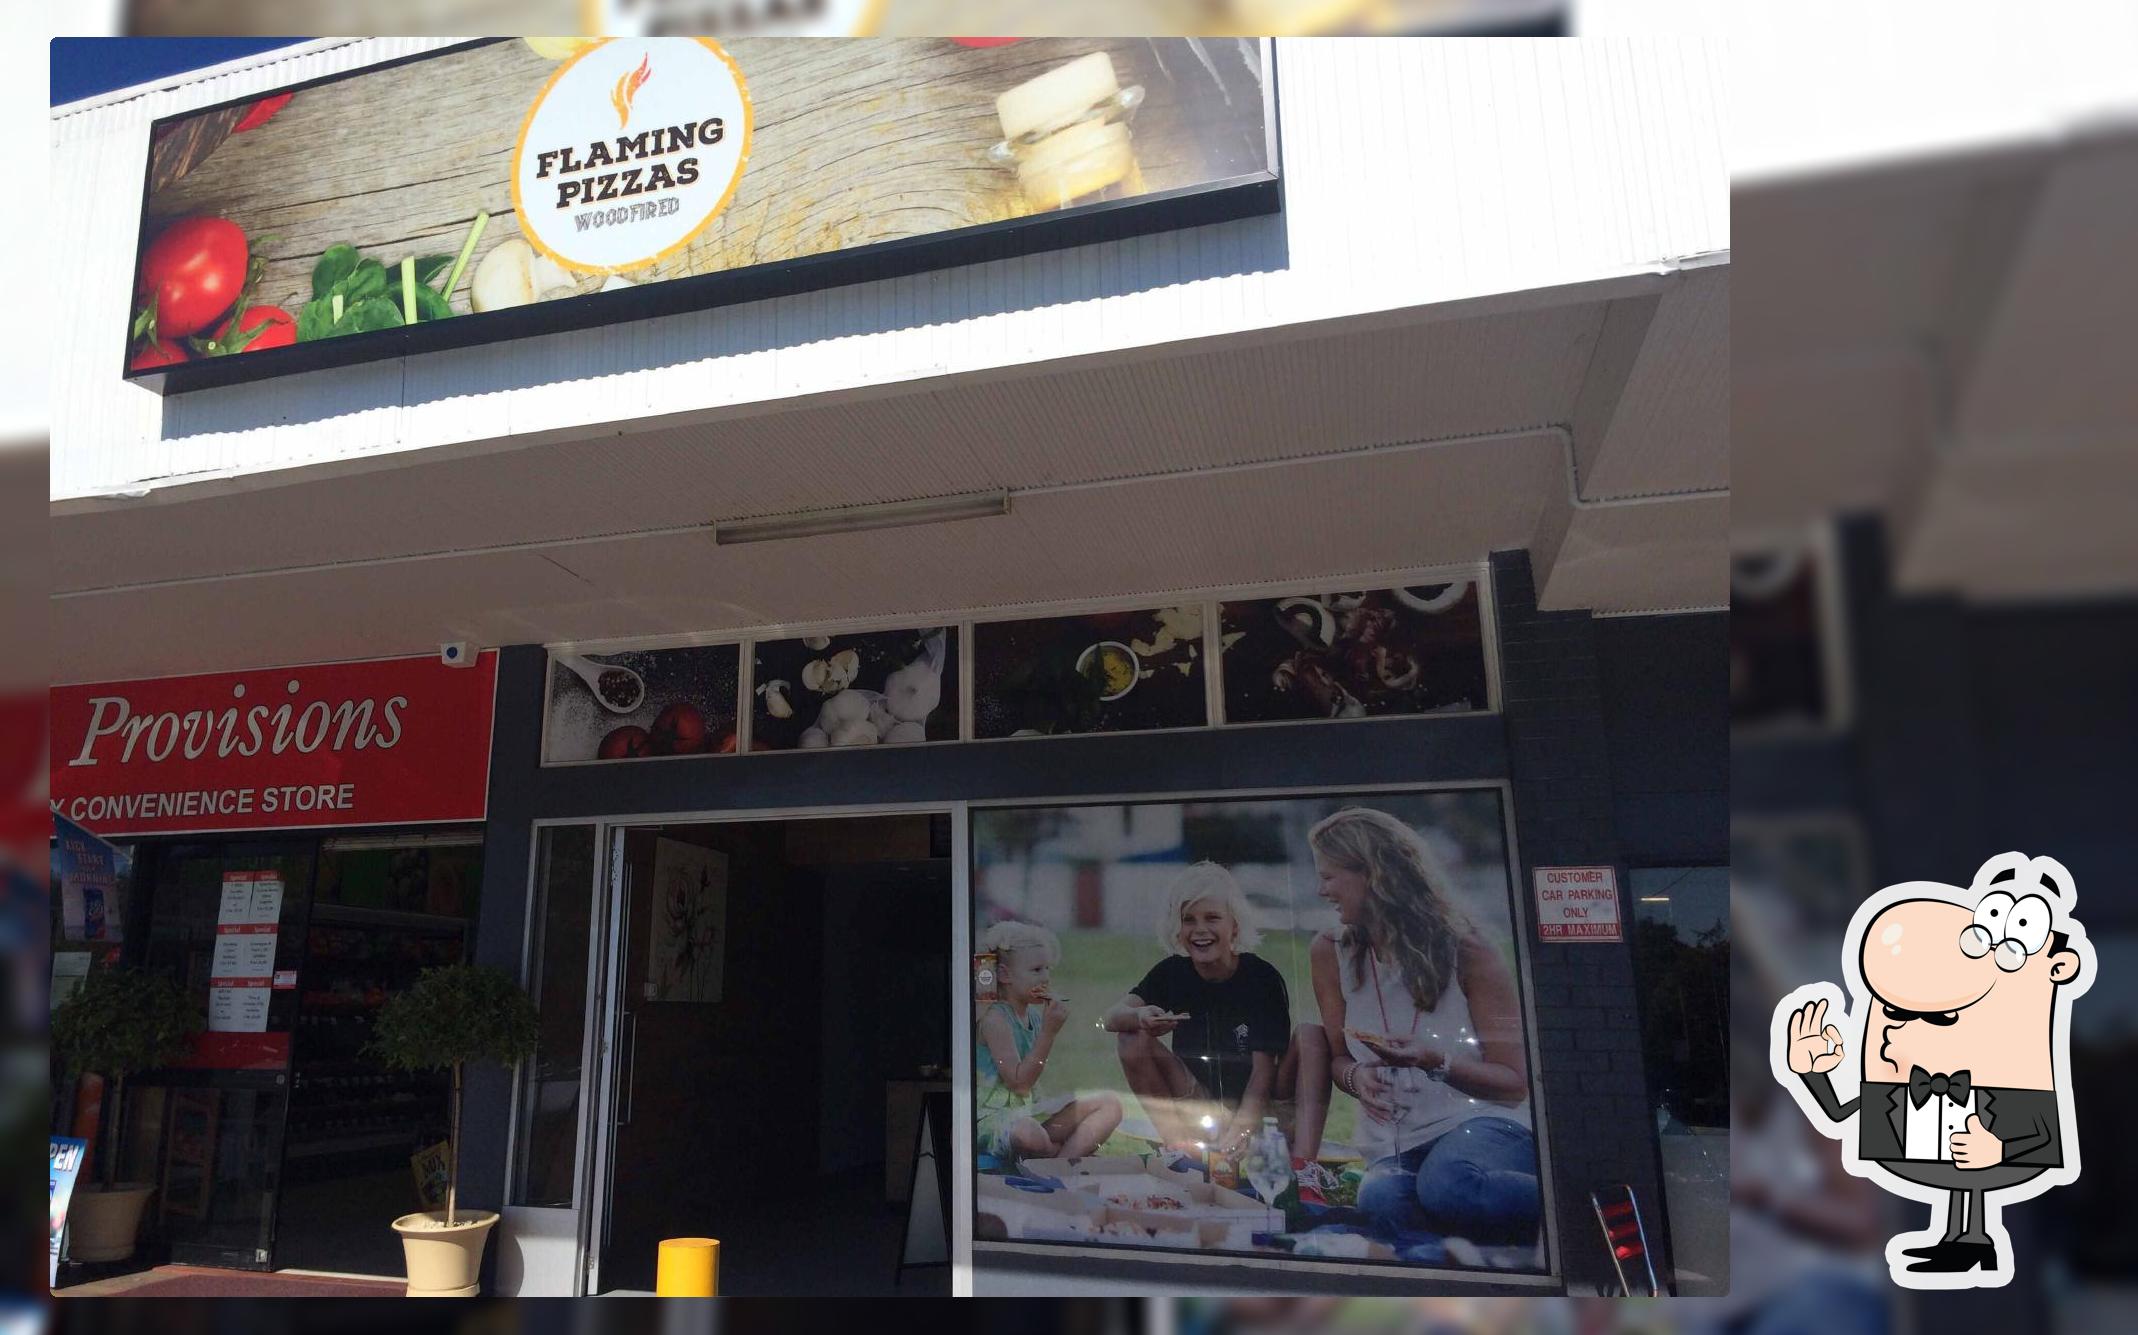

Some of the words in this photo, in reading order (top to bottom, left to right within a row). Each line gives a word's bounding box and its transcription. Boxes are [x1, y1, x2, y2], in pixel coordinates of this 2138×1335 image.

[536, 117, 724, 179] FLAMING
[556, 157, 700, 209] PIZZAS
[574, 197, 680, 232] WOODFIRED
[68, 679, 408, 767] Provisions
[70, 788, 255, 821] CONVENIENCE
[261, 784, 355, 812] STORE
[1546, 871, 1603, 883] CUSTOMER
[1541, 889, 1564, 901] CAR
[1568, 889, 1613, 900] PARKING
[1563, 906, 1589, 918] ONLY
[1543, 924, 1563, 936] 2HR
[1567, 924, 1618, 936] MAXIMUM
